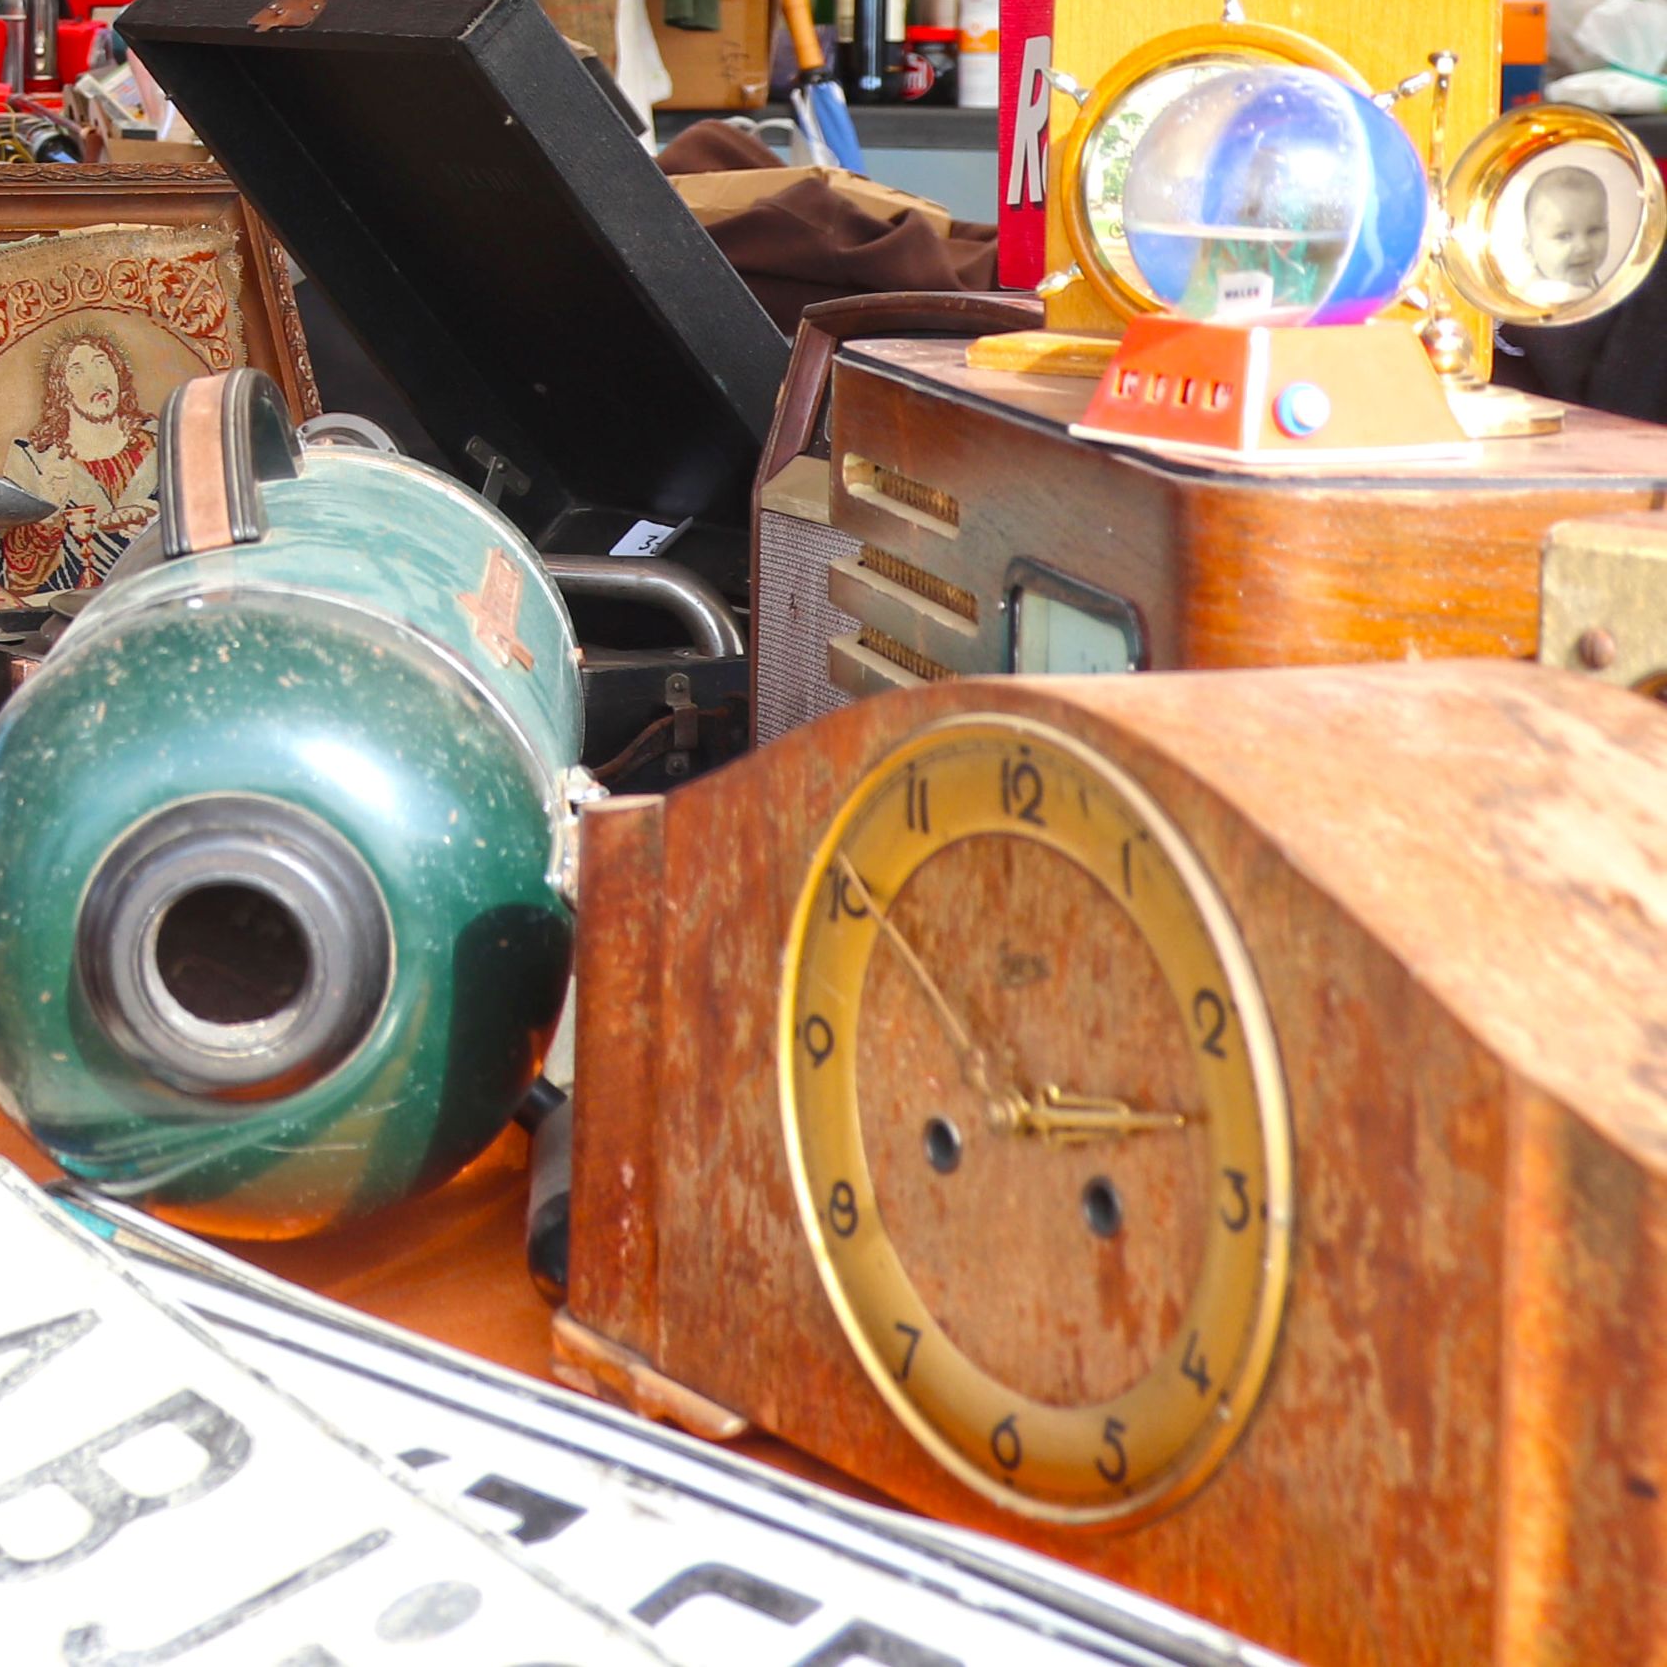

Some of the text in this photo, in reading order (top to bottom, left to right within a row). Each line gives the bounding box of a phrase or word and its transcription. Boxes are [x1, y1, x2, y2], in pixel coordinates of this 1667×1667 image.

[1005, 34, 1051, 206] R
[907, 762, 931, 834] 11
[1002, 758, 1046, 827] 12
[827, 862, 872, 922] 10
[802, 1015, 835, 1068] 9
[1194, 988, 1229, 1057] 2
[829, 1179, 859, 1238] 8
[1220, 1169, 1252, 1233] 3
[894, 1324, 922, 1384] 7
[1181, 1334, 1213, 1396] 4
[991, 1414, 1023, 1472] 6
[1094, 1418, 1129, 1486] 5
